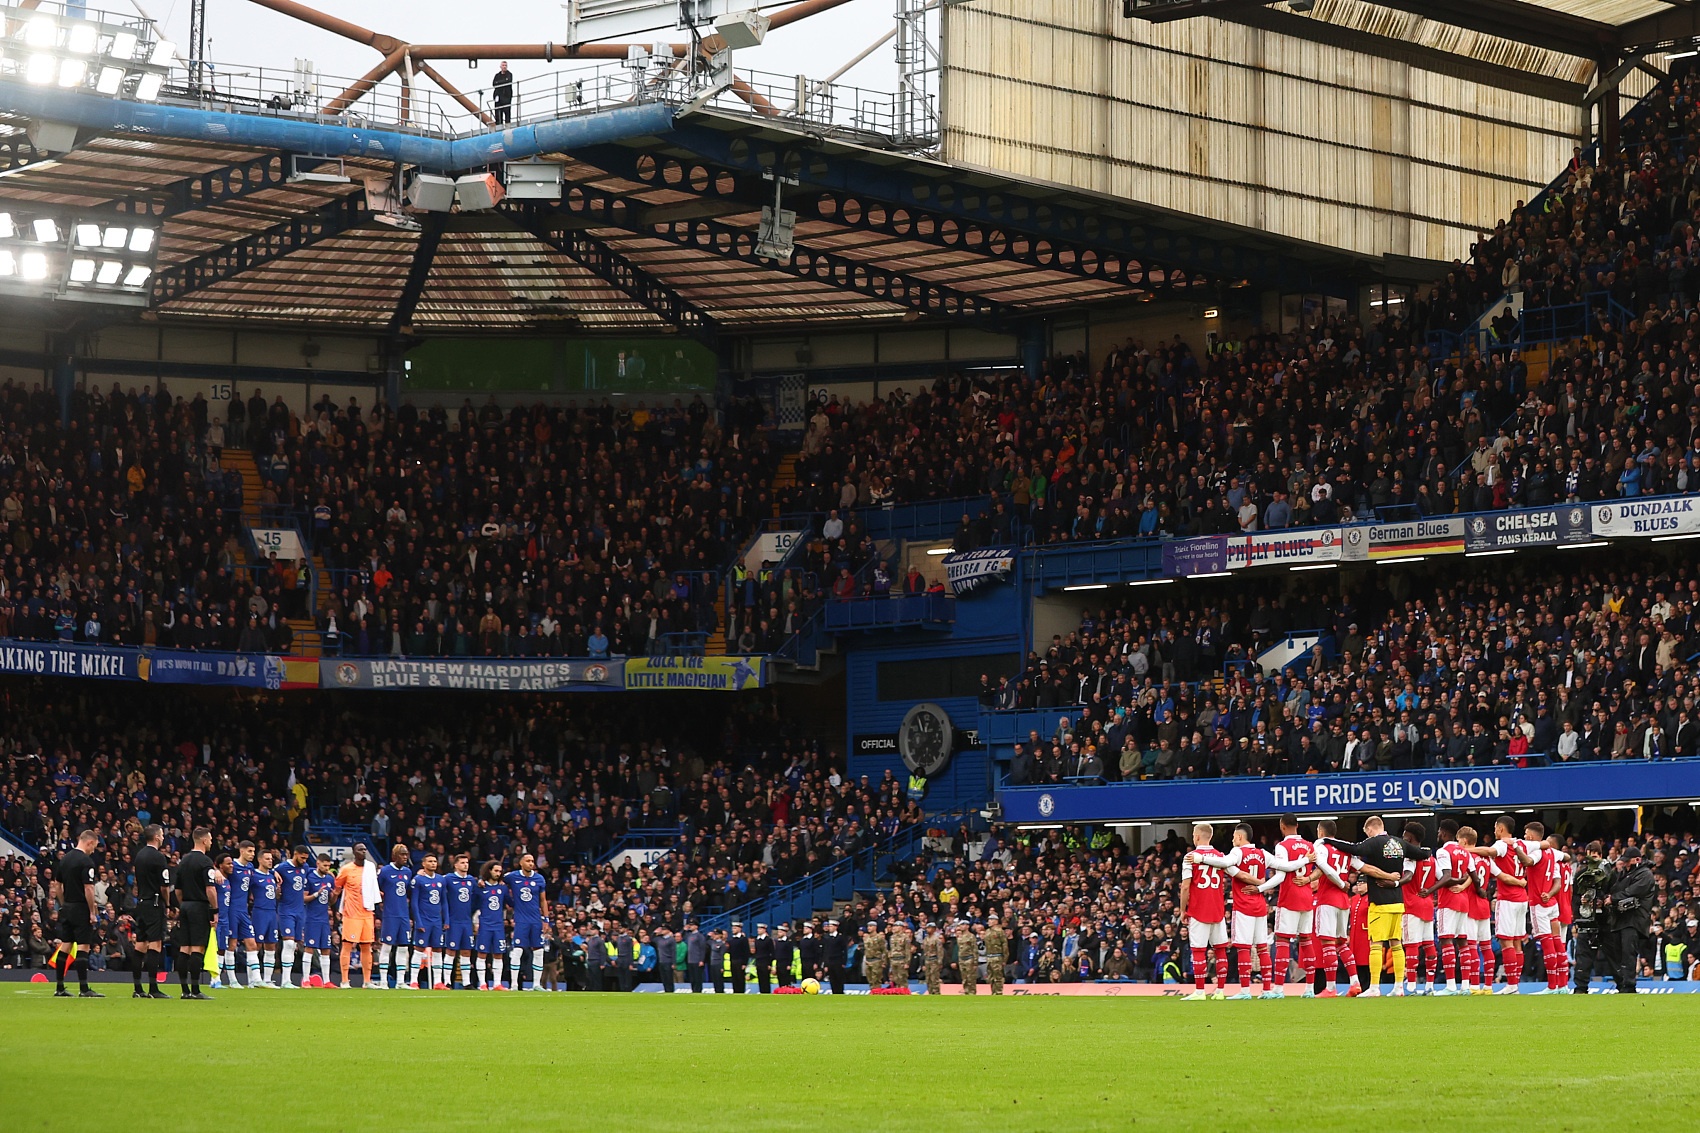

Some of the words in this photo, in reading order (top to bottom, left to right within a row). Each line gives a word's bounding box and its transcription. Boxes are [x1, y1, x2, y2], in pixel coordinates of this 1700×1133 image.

[211, 384, 231, 400] 15
[1620, 500, 1693, 518] DUNDALK
[1496, 512, 1558, 531] CHELSEA
[1634, 517, 1679, 533] BLUES
[264, 532, 282, 546] 15
[1369, 526, 1414, 540] German
[1417, 522, 1450, 537] Blues
[1497, 533, 1521, 546] FANS
[1522, 531, 1558, 543] KERALA
[775, 534, 792, 548] 16
[1227, 542, 1269, 561] PHILLY
[1274, 538, 1314, 558] BLUES
[948, 562, 980, 579] CHELSEA
[50, 650, 77, 674] THE
[81, 653, 127, 677] MIKEL
[157, 659, 174, 670] HE'S
[193, 661, 200, 671] IT
[201, 662, 213, 672] ALL
[370, 661, 464, 674] MATTHEW
[470, 663, 571, 678] HARDING'S
[266, 678, 280, 690] 28
[373, 674, 420, 687] BLUE
[428, 674, 442, 686] &
[448, 676, 510, 690] WHITE
[627, 672, 665, 688] LITTLE
[667, 672, 727, 689] MAGICIAN
[861, 739, 896, 750] OFFICIAL
[1270, 785, 1309, 807] THE
[1315, 783, 1377, 805] PRIDE
[1383, 781, 1402, 796] OF
[1408, 777, 1500, 801] LONDON
[1331, 853, 1349, 874] 34
[1545, 859, 1552, 881] 4
[1197, 864, 1221, 889] 35
[1422, 865, 1432, 889] 7
[1478, 865, 1486, 888] 8
[1564, 870, 1571, 893] 9
